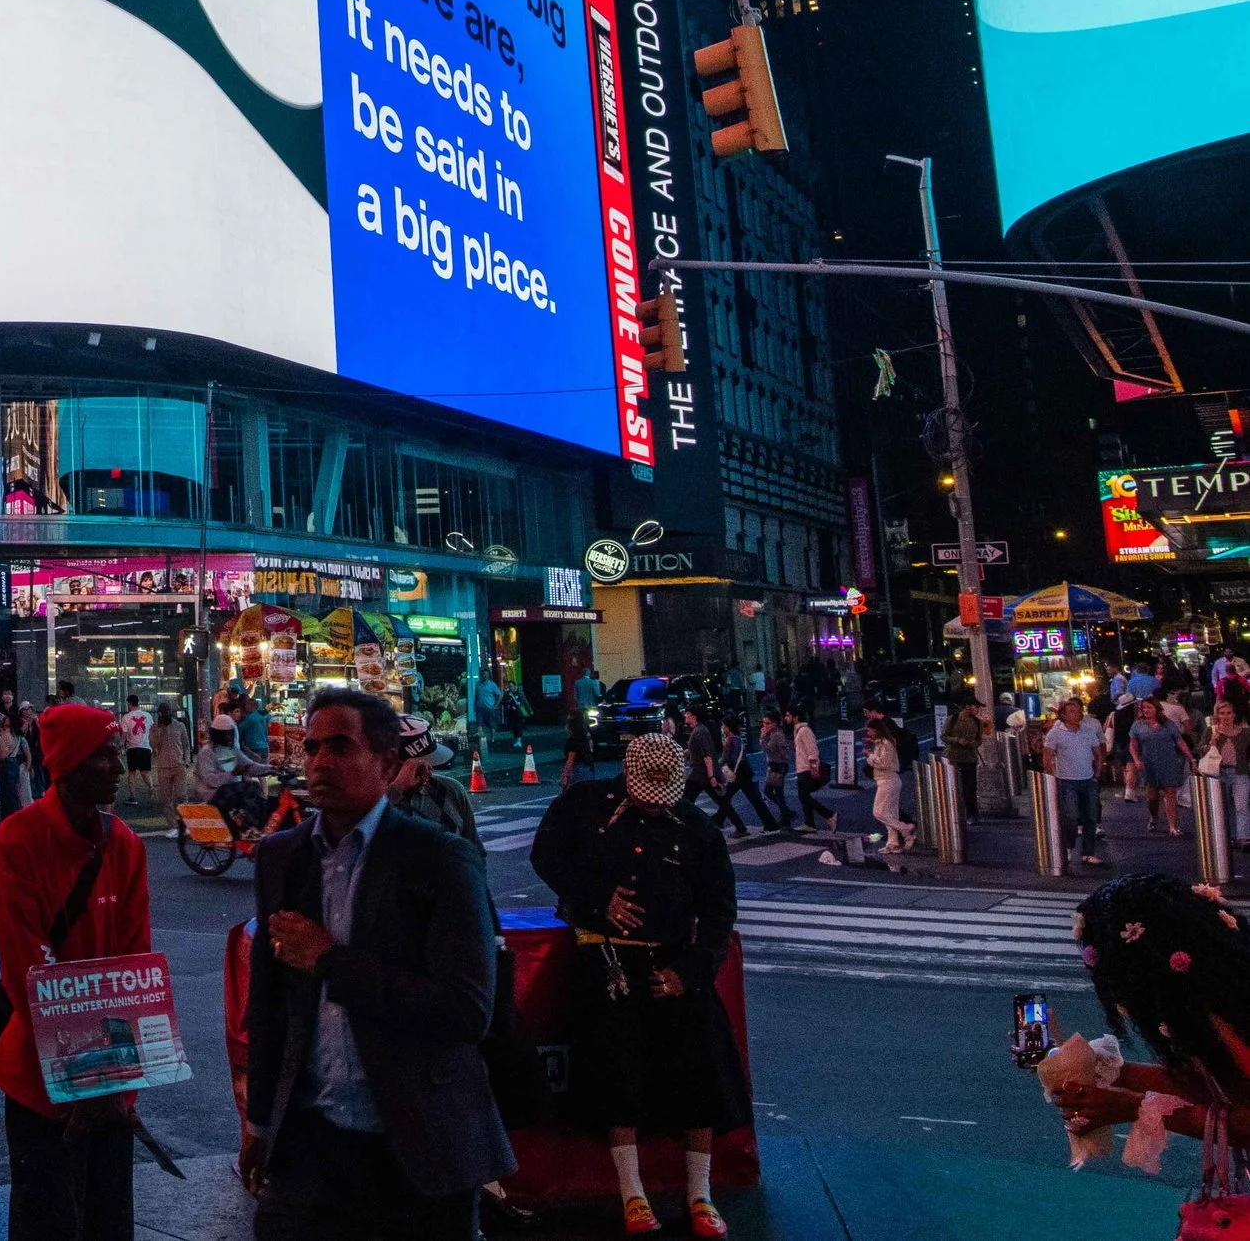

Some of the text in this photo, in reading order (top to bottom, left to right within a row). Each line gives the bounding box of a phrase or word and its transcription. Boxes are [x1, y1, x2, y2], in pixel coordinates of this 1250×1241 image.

[465, 0, 524, 84] are,
[384, 18, 493, 129] needs
[500, 89, 532, 152] to
[599, 33, 621, 162] HERSHEY'S
[351, 71, 525, 222] be said in
[645, 126, 676, 202] AND
[357, 183, 384, 237] a
[394, 185, 454, 280] big
[464, 231, 558, 315] place.
[609, 206, 641, 344] COME
[621, 354, 651, 465] INSI
[669, 381, 698, 451] THE
[1142, 471, 1250, 498] TEMP
[588, 549, 626, 571] HERSHEY'S
[1114, 552, 1177, 563] FAVORITE SHOWS
[1119, 545, 1170, 555] STREAM YOUR
[564, 611, 583, 620] CHOCOLATE
[1016, 609, 1065, 620] SABRETT
[404, 734, 430, 758] NEW
[36, 967, 165, 1002] NIGHT TOUR
[40, 991, 166, 1017] WITH ENTERTAINING HOST
